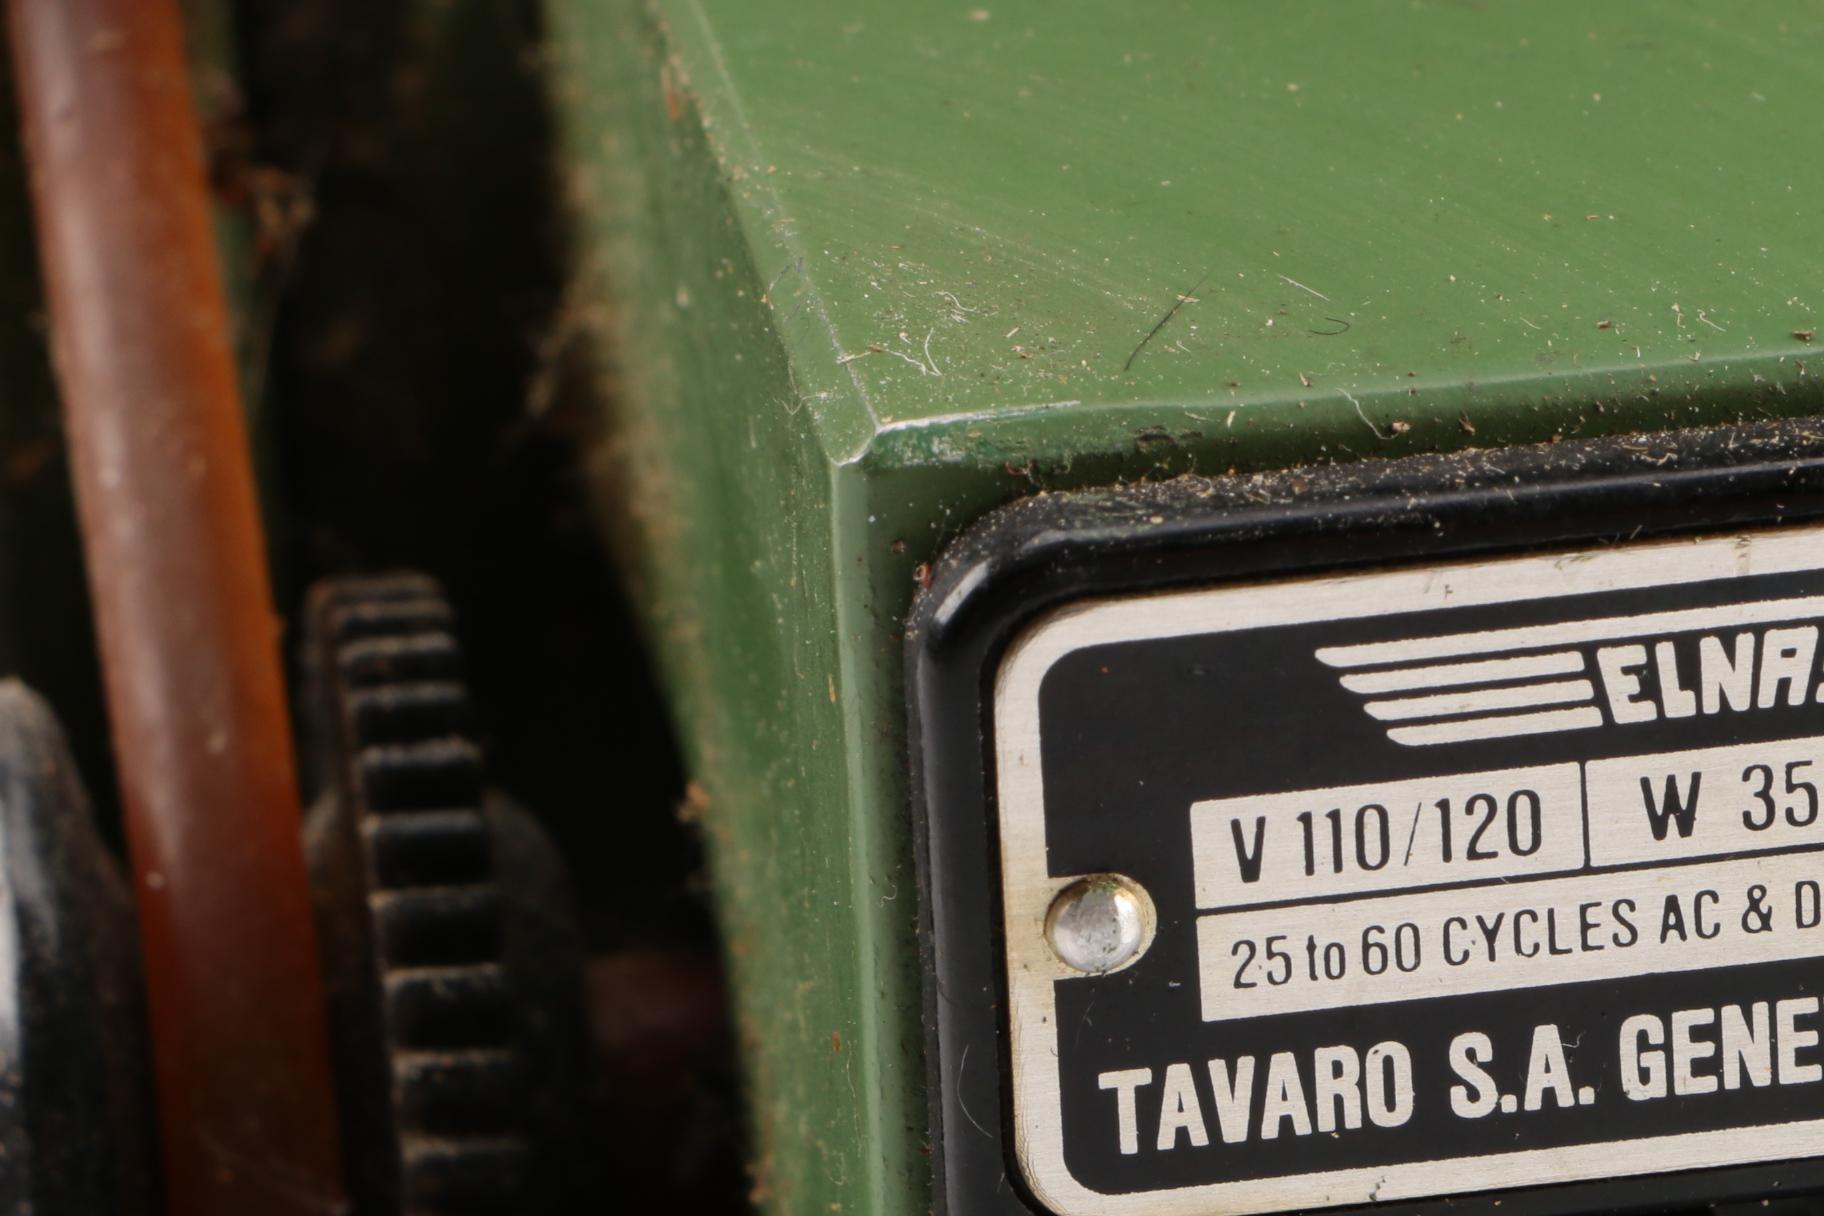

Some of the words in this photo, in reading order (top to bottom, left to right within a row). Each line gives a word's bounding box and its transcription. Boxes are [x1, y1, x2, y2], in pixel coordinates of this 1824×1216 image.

[1595, 625, 1820, 726] ELNA
[1230, 815, 1267, 883] V
[1296, 789, 1542, 876] 110/120
[1639, 770, 1702, 842] W
[1740, 759, 1820, 831] 35
[1230, 936, 1293, 989] 25
[1306, 934, 1347, 983] to
[1361, 922, 1421, 975] 60
[1442, 901, 1639, 967] CYCLES
[1658, 888, 1720, 945] AC
[1740, 885, 1774, 935] &
[1098, 1040, 1415, 1155] TAVARO
[1448, 1023, 1595, 1119] S.A.
